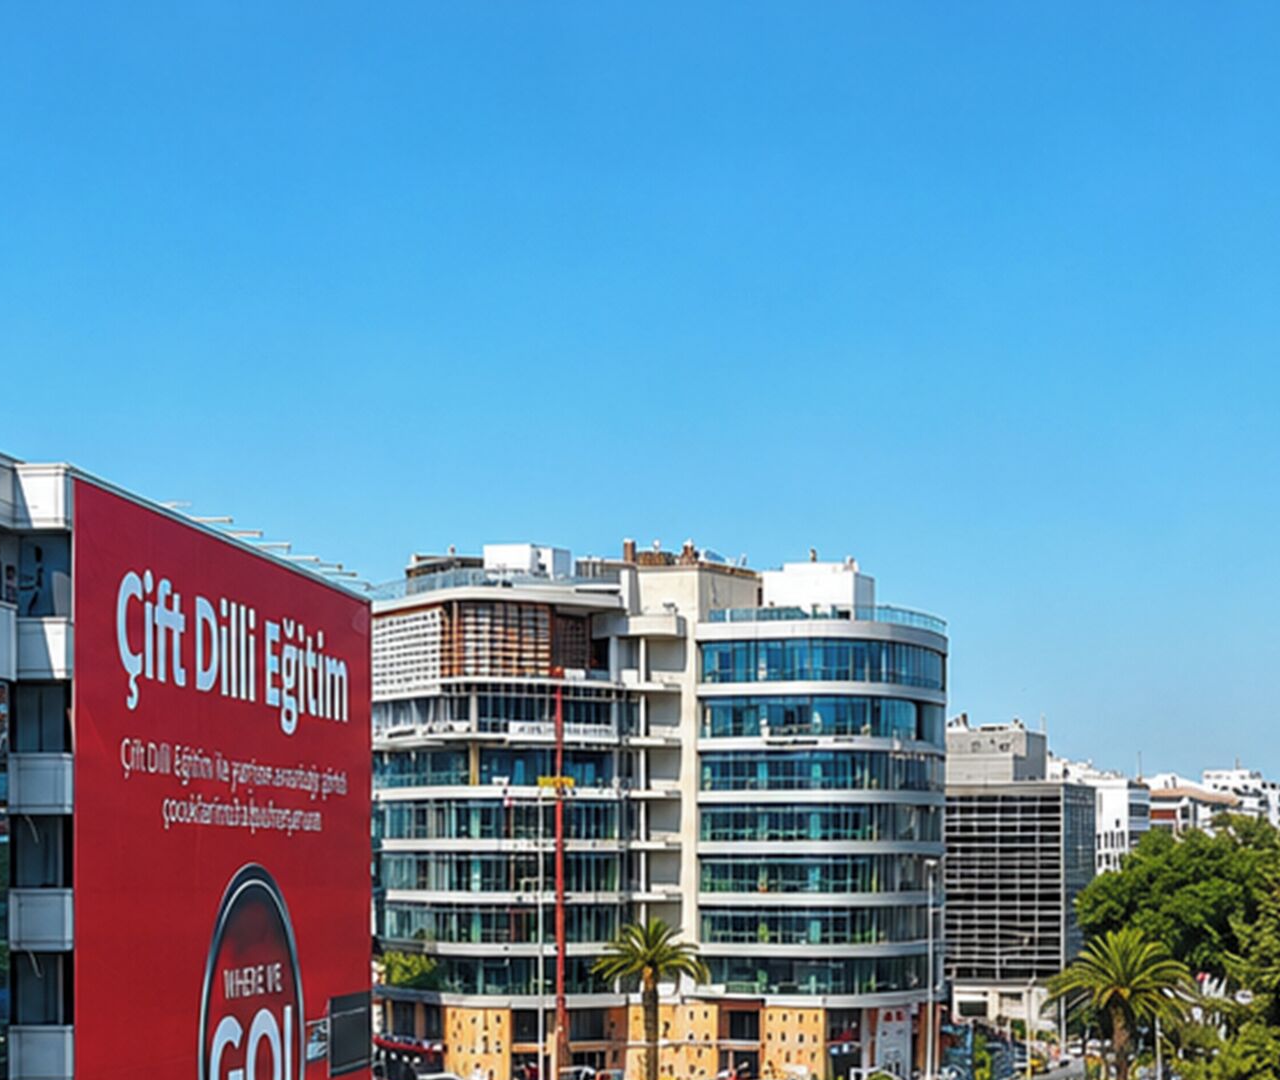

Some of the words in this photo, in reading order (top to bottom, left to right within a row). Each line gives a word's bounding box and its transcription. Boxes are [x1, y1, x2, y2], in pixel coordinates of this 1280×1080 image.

[117, 569, 186, 710] Çift
[195, 596, 256, 702] Dilli
[265, 617, 348, 735] Eğitim
